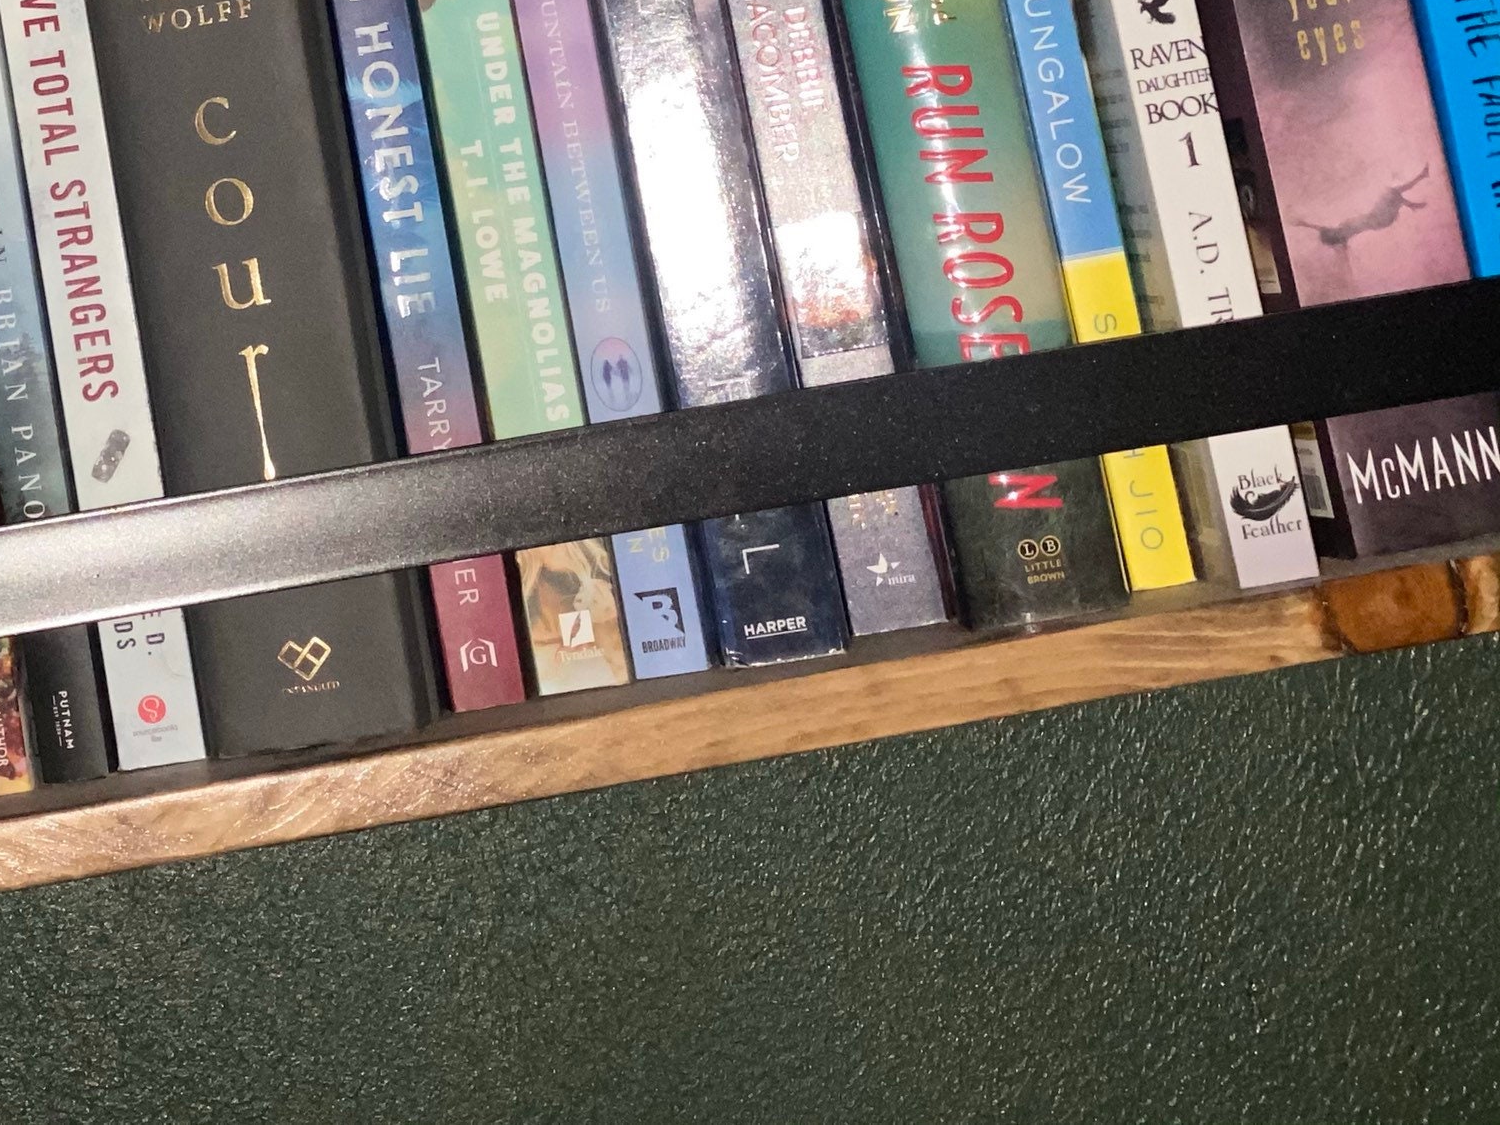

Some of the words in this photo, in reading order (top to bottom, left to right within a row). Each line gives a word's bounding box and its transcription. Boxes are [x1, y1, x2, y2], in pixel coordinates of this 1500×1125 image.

[476, 11, 517, 126] UNDER
[1297, 19, 1365, 66] eyes
[29, 49, 80, 166] TOTAL
[354, 22, 425, 223] HONEST
[900, 64, 995, 184] RUN
[1144, 92, 1220, 125] BOOK
[500, 137, 531, 206] THE
[1178, 131, 1201, 168] 1
[562, 120, 604, 268] BETWEEN
[591, 275, 610, 313] US
[388, 247, 436, 319] LIE
[471, 209, 509, 304] LOWE
[932, 212, 1031, 361] ROSE
[49, 178, 121, 403] STRANGERS
[512, 217, 570, 422] MAGNOLIAS
[11, 423, 46, 520] PANO
[1238, 462, 1284, 490] Black
[1241, 518, 1304, 541] Feather
[887, 573, 916, 586] mira
[1023, 560, 1063, 573] LITTLE
[1027, 571, 1066, 585] BROWN
[557, 645, 604, 663] Tyndale
[642, 636, 687, 654] BROADWAY
[744, 616, 806, 638] HARPER
[58, 689, 76, 750] PUTNAM
